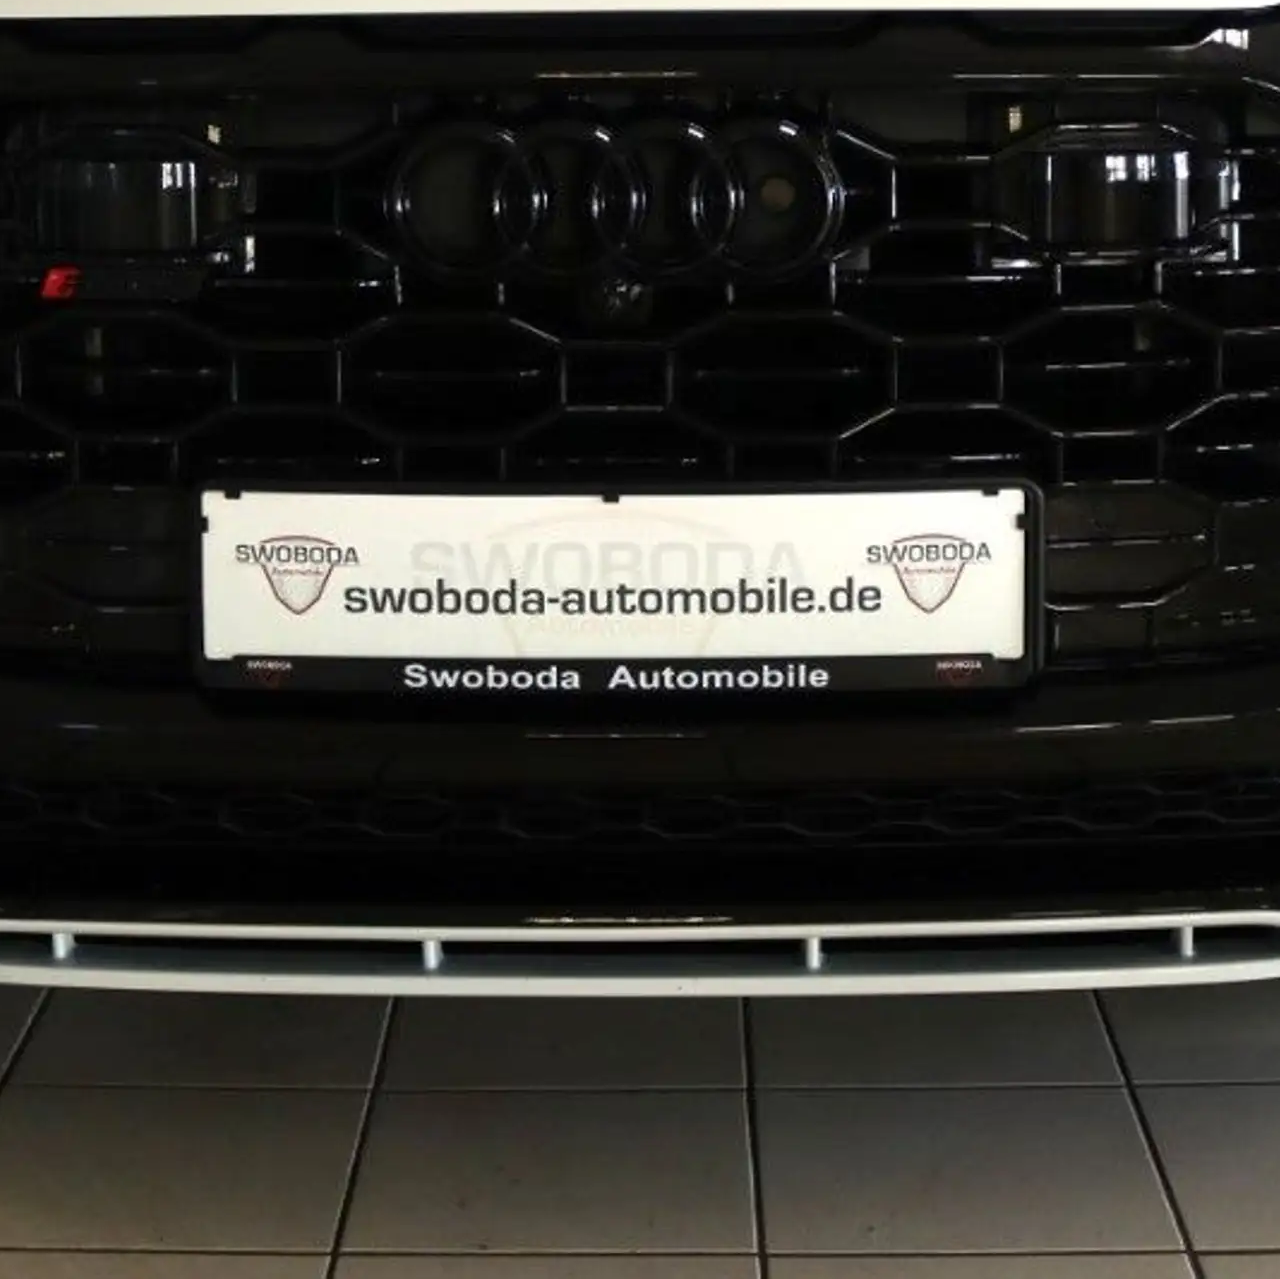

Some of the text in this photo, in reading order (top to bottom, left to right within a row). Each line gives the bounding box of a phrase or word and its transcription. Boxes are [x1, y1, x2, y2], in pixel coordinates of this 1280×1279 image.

[235, 544, 359, 565] SWOBODA
[866, 543, 992, 564] SWOBODA
[343, 577, 883, 615] swoboda-automobile.de
[403, 663, 830, 690] Swoboda Automobile
